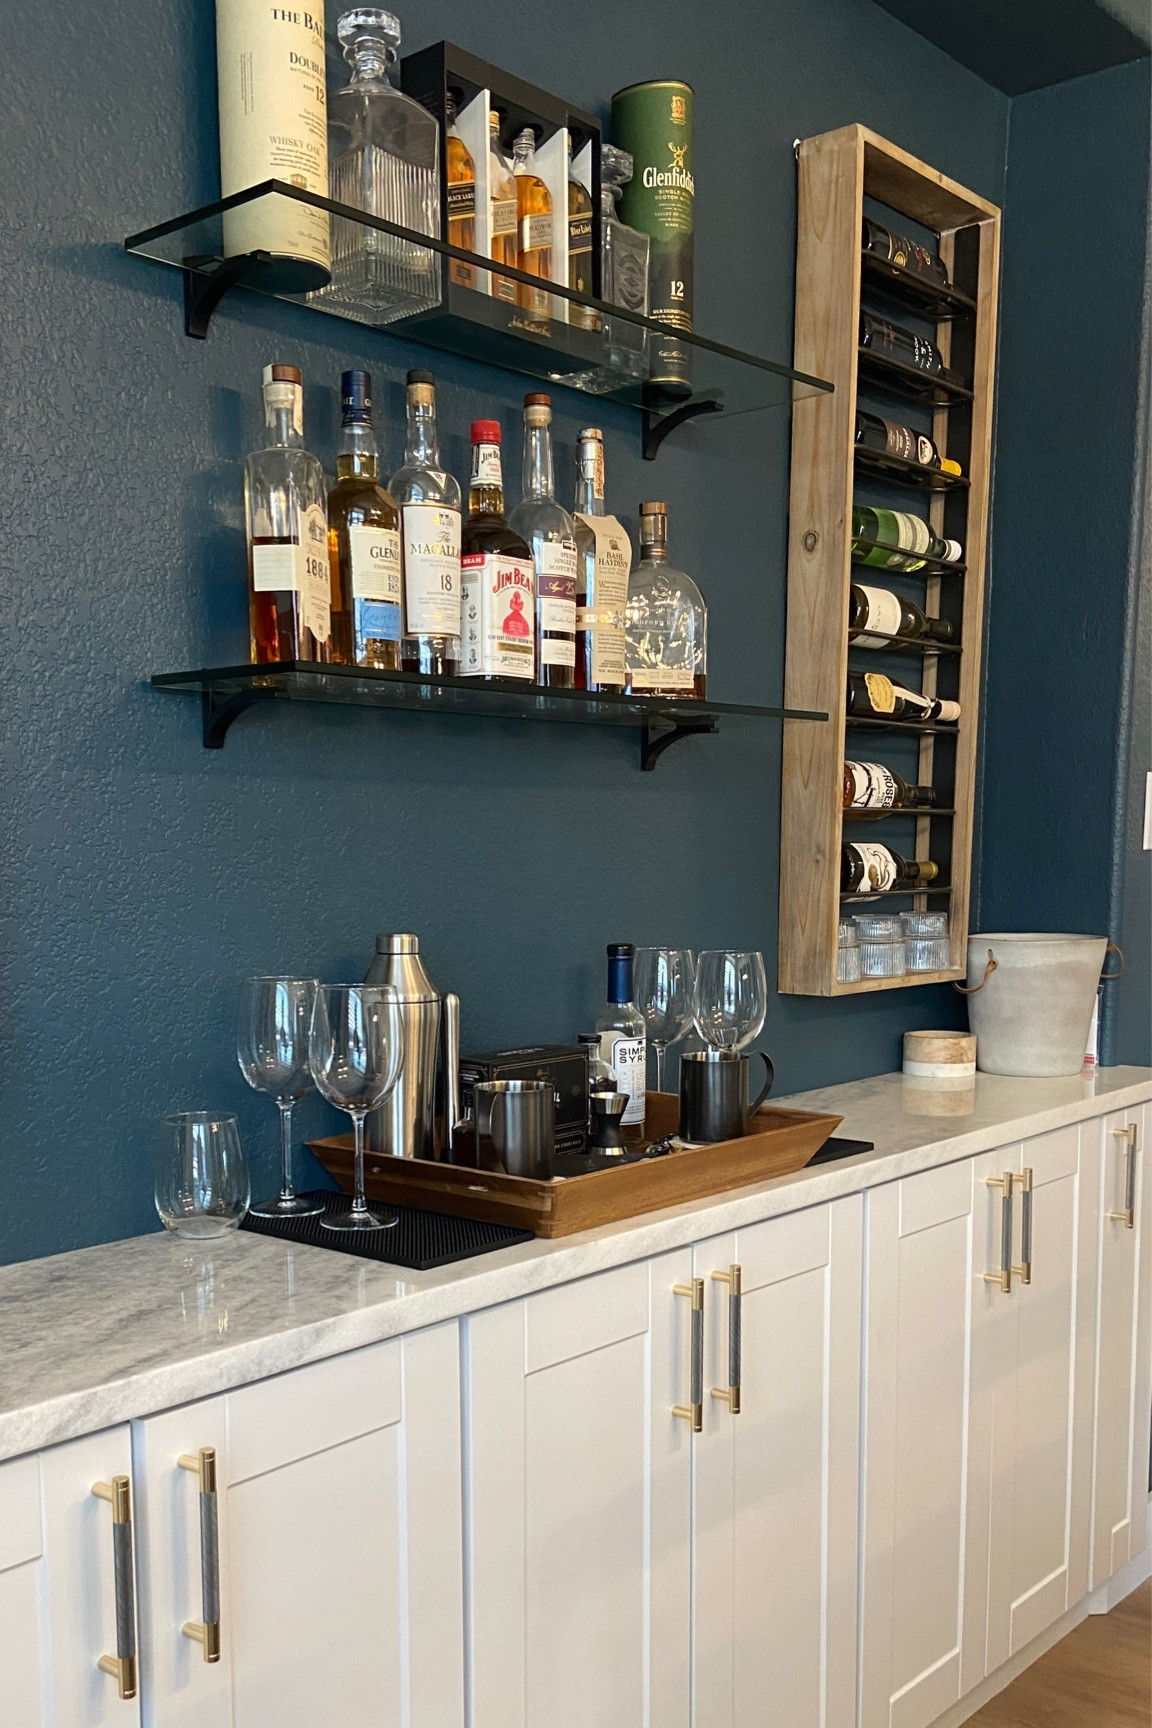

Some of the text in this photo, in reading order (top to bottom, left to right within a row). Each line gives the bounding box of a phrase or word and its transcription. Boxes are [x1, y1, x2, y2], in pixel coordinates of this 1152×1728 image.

[271, 8, 300, 25] THE
[316, 86, 325, 106] 12
[270, 136, 304, 149] WHISKY
[670, 280, 684, 297] 12
[481, 452, 492, 464] JIM
[436, 531, 450, 543] The
[463, 557, 482, 565] BEAM
[606, 552, 623, 561] BASIL
[440, 574, 452, 591] 18
[492, 570, 513, 593] JIM
[882, 774, 894, 808] ROSES
